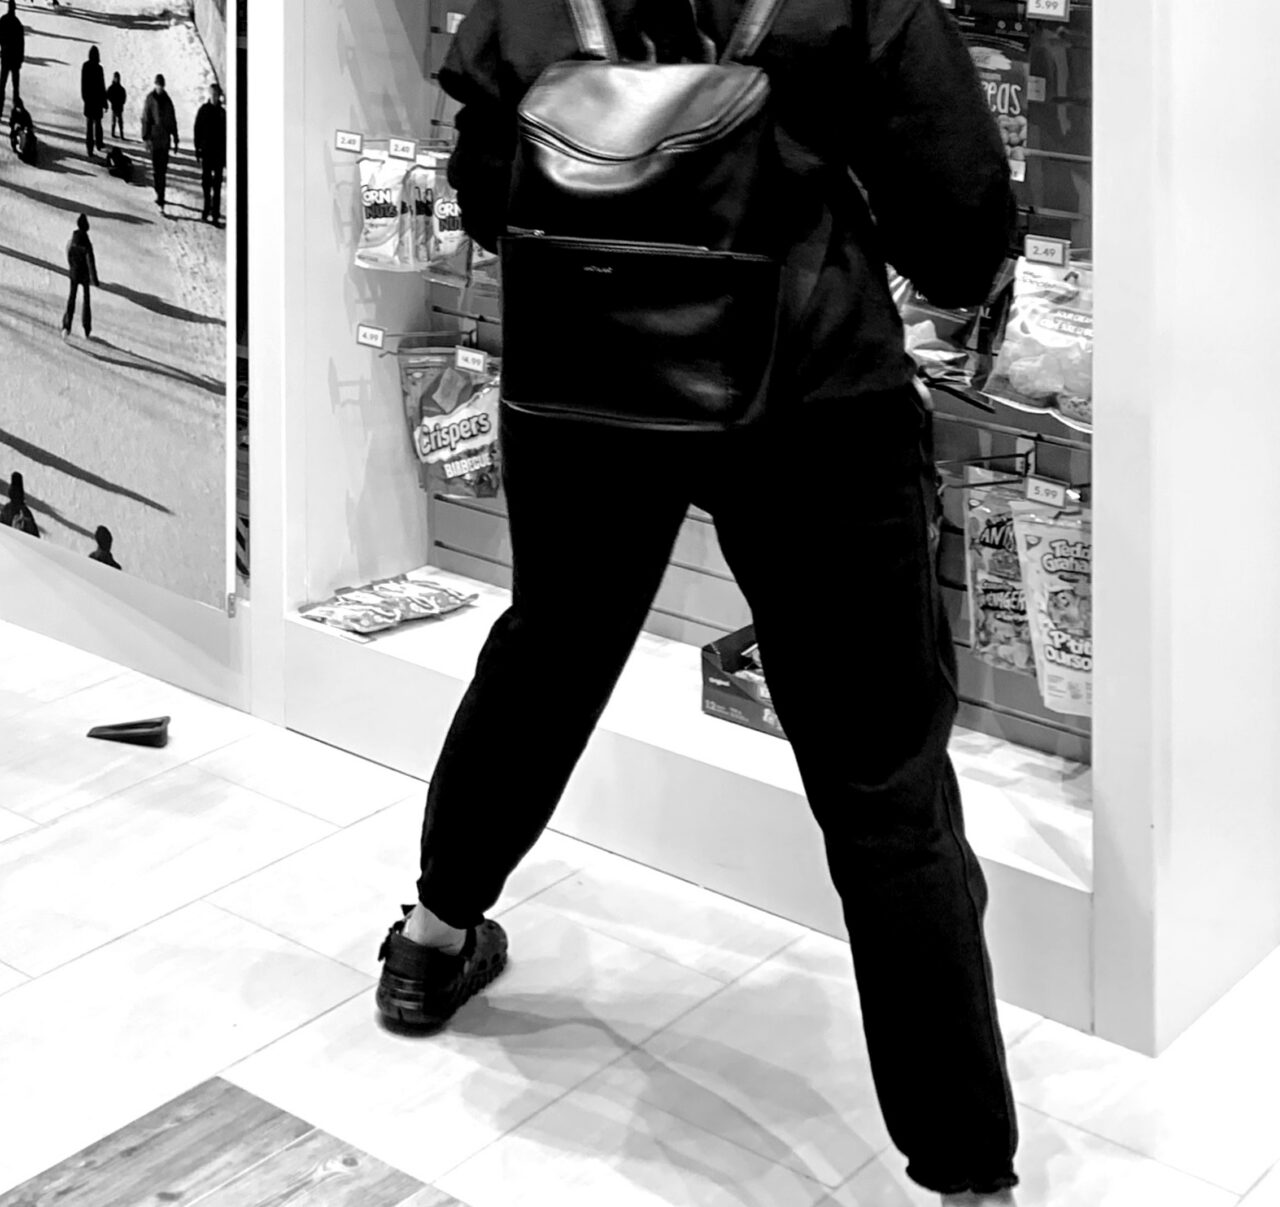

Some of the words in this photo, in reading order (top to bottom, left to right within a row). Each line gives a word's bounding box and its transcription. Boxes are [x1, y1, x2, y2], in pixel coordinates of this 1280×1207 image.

[1035, 0, 1058, 10] 5.99
[361, 184, 392, 207] CORN
[1033, 246, 1056, 257] 2.49
[361, 331, 379, 342] 4.99
[419, 413, 492, 457] Crispers
[1035, 486, 1057, 498] 5.99
